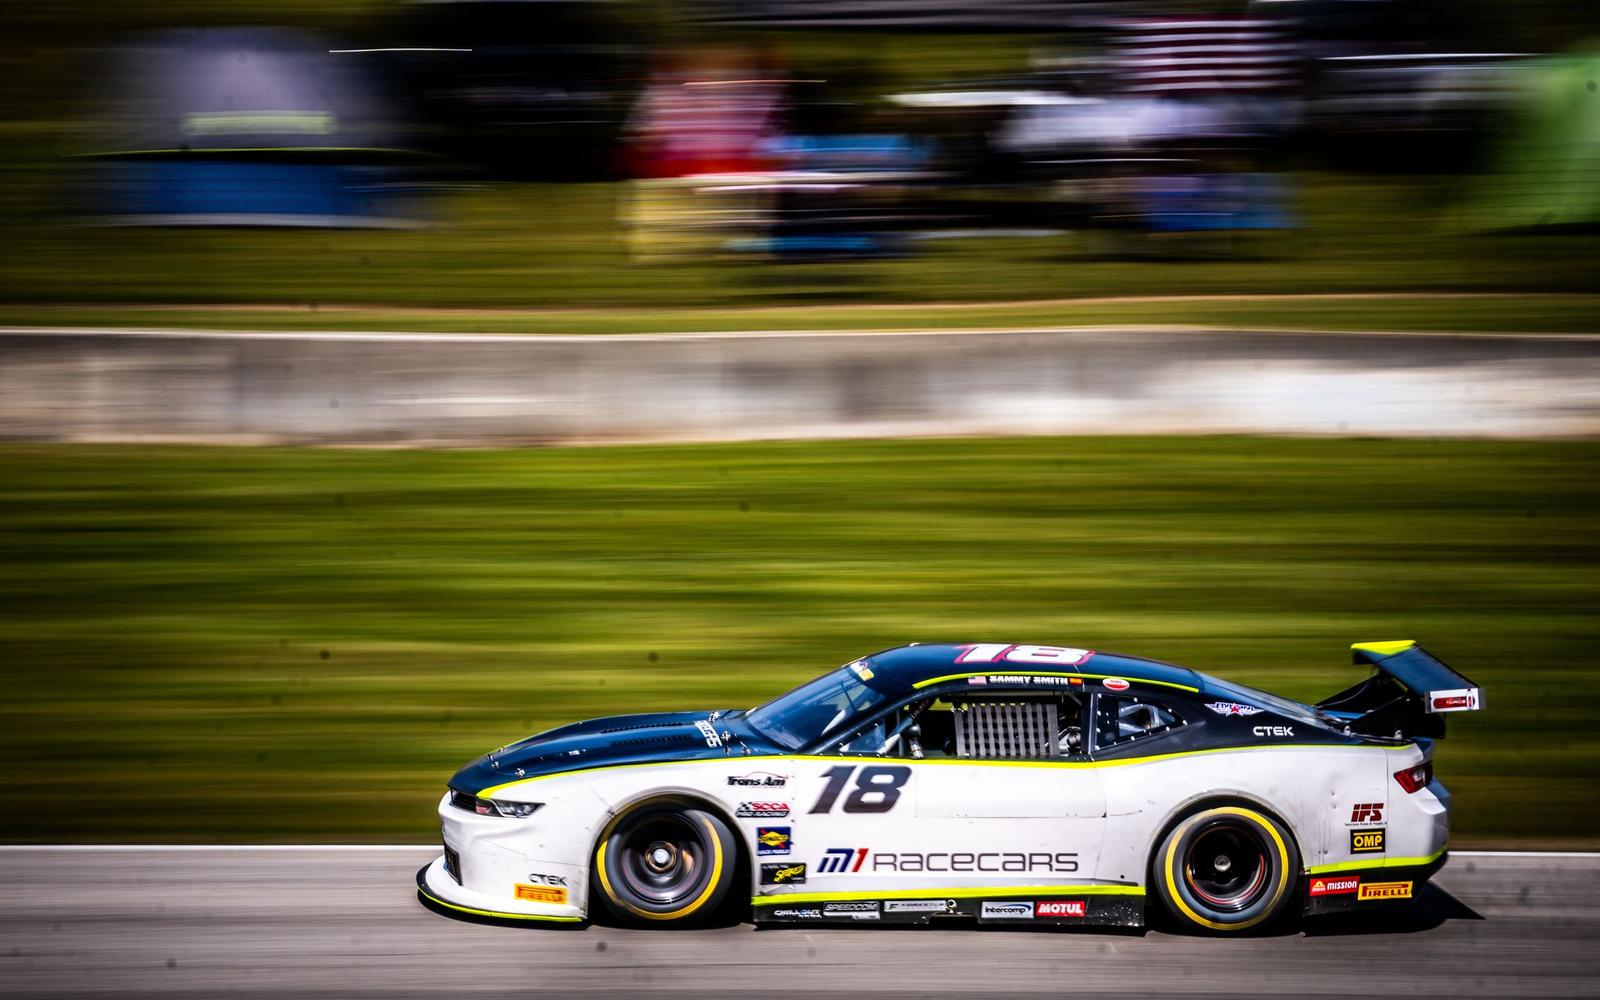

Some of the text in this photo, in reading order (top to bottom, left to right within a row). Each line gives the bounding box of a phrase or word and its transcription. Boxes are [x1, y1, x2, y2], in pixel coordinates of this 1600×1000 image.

[954, 643, 1095, 665] 18
[989, 675, 1069, 685] SAMMY SMITH
[1253, 726, 1294, 736] CTEK
[727, 776, 786, 786] Trans Am
[808, 765, 912, 814] 18
[752, 803, 789, 811] SCCA
[1351, 803, 1384, 822] IFS
[1354, 835, 1382, 847] OMP
[529, 873, 567, 886] CTEK
[1327, 881, 1357, 890] MISSION
[1361, 884, 1409, 897] PIRELLI
[985, 905, 1026, 915] Intercomp
[1038, 903, 1082, 914] MOTUL
